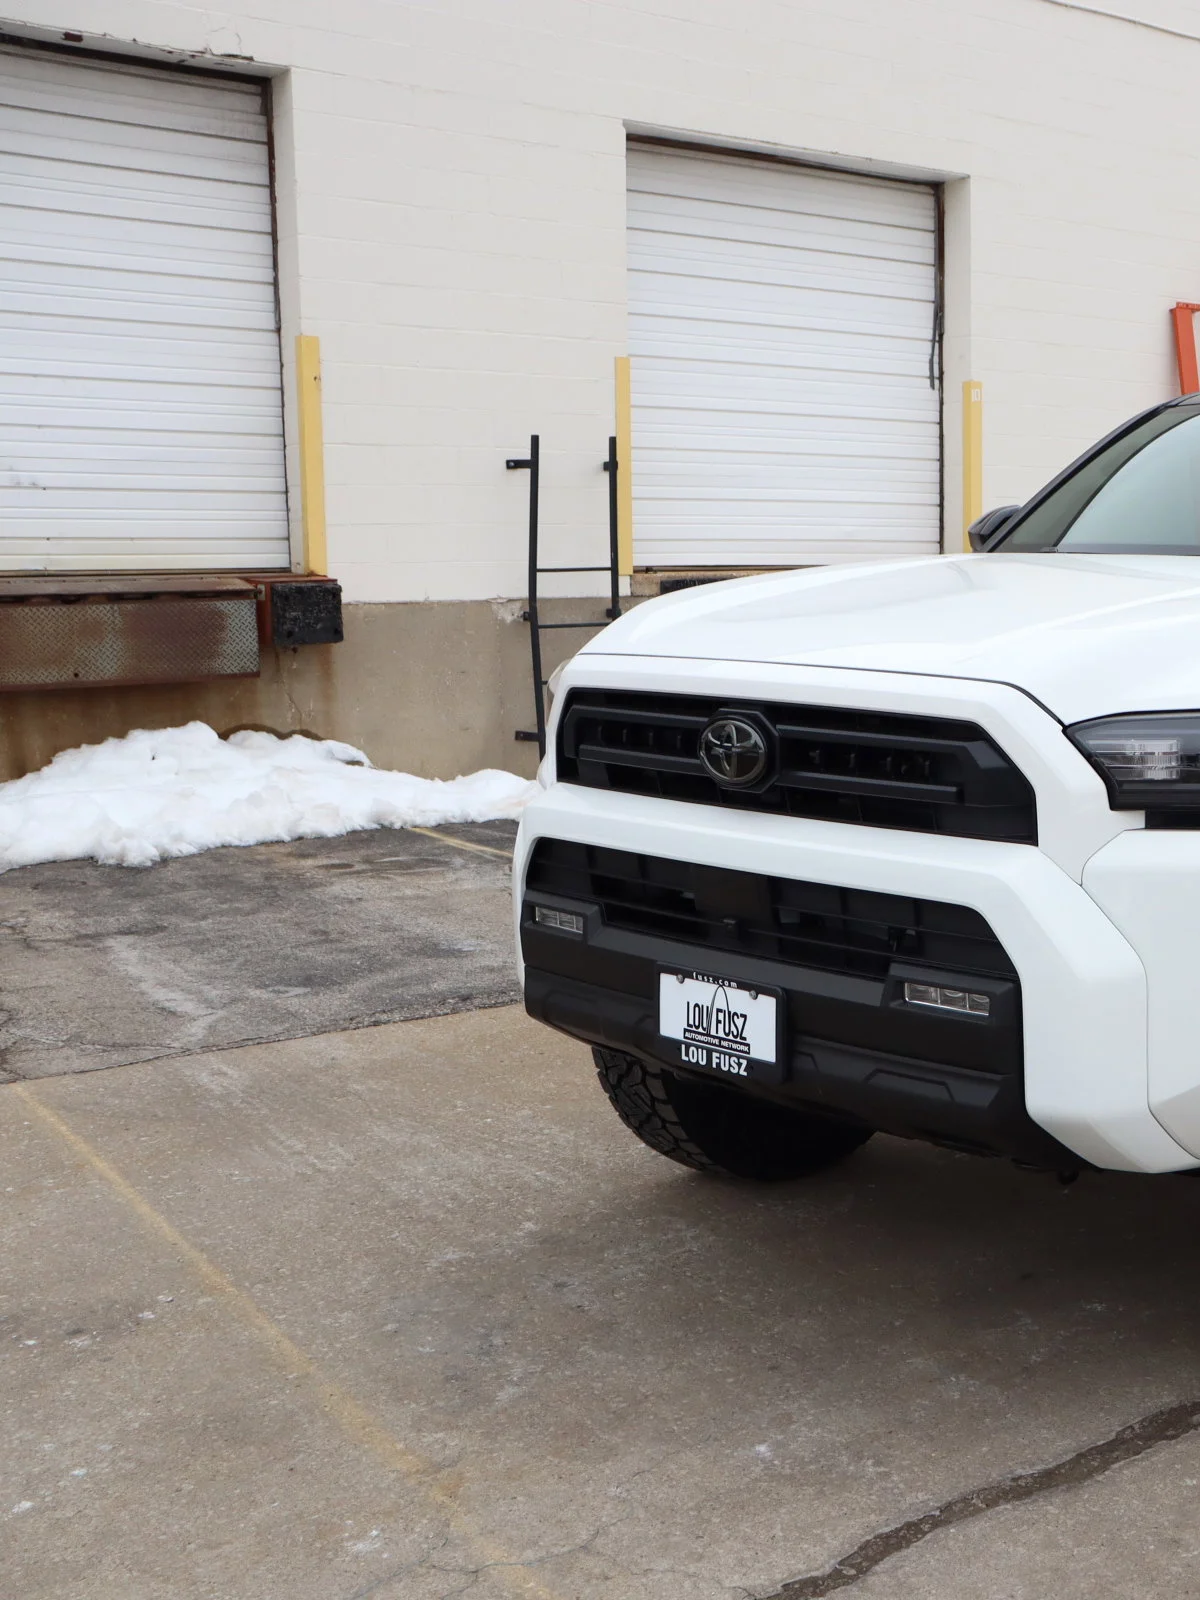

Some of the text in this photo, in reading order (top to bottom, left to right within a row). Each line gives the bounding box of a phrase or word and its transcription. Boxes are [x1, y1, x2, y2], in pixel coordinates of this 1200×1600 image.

[693, 971, 737, 988] fusz.com
[686, 1001, 747, 1041] LOU FUSZ
[685, 1031, 749, 1052] AUTOMOTIVE NETWORK
[681, 1044, 748, 1076] LOU FUSZ
